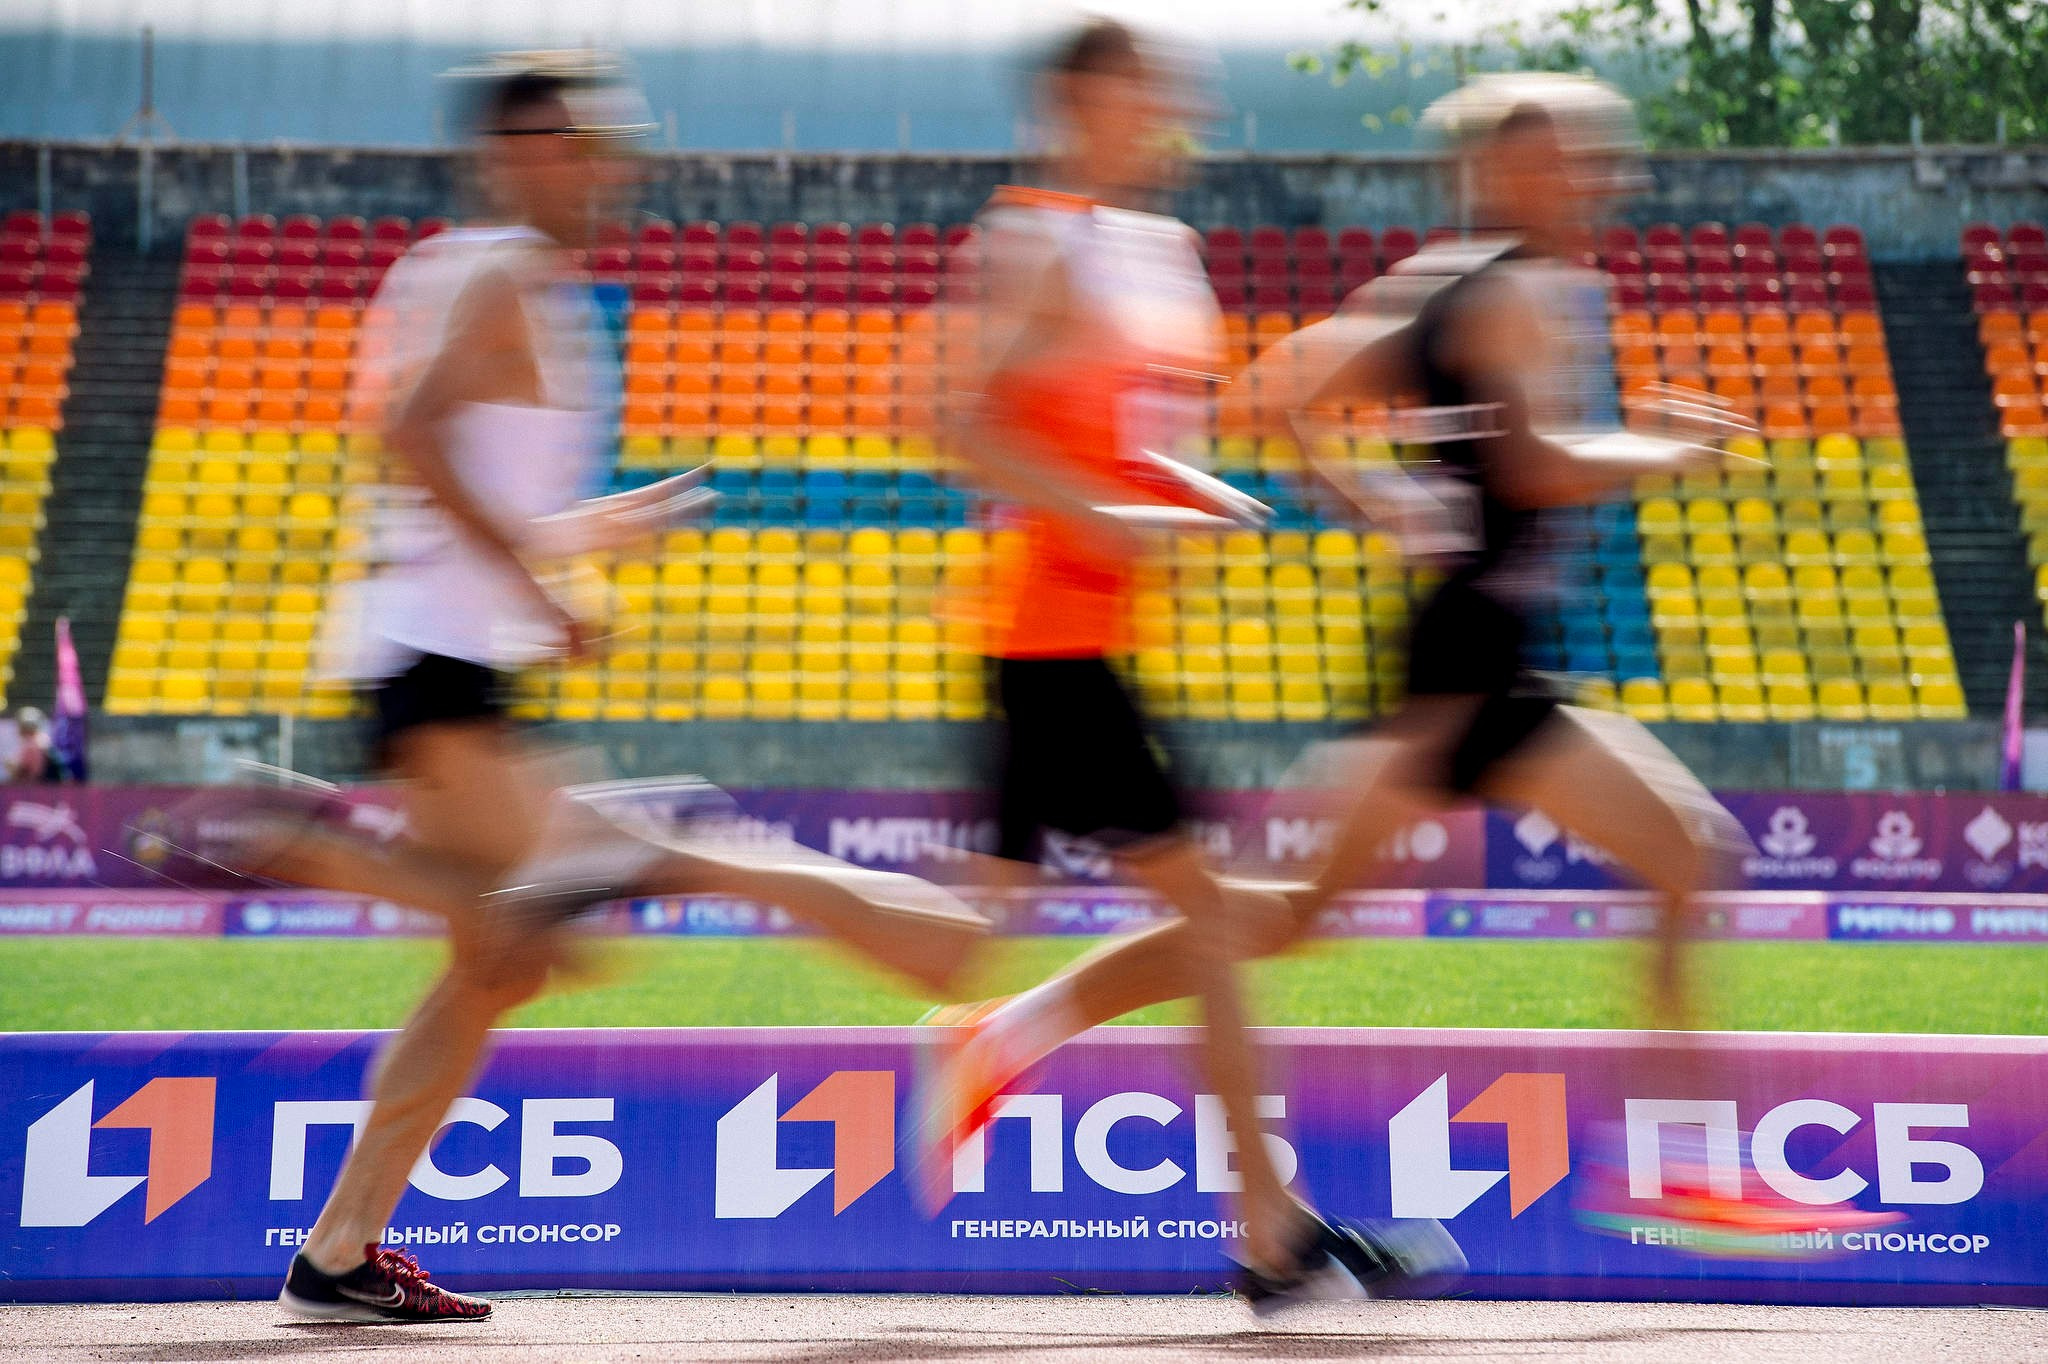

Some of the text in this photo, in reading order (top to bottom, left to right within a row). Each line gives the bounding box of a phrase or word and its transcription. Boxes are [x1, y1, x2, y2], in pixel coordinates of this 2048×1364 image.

[270, 1097, 624, 1201] ПСБ
[952, 1092, 1298, 1195] ПСБ
[1624, 1098, 1985, 1205] ПСБ
[265, 1222, 621, 1247] ГЕНЬНЫЙ СПОНСОР
[951, 1216, 1250, 1239] ГЕНЕРАЛЬНЫЙ СПОН
[1631, 1227, 1990, 1254] ГЕНЕНЫЙ СПОНСОР
